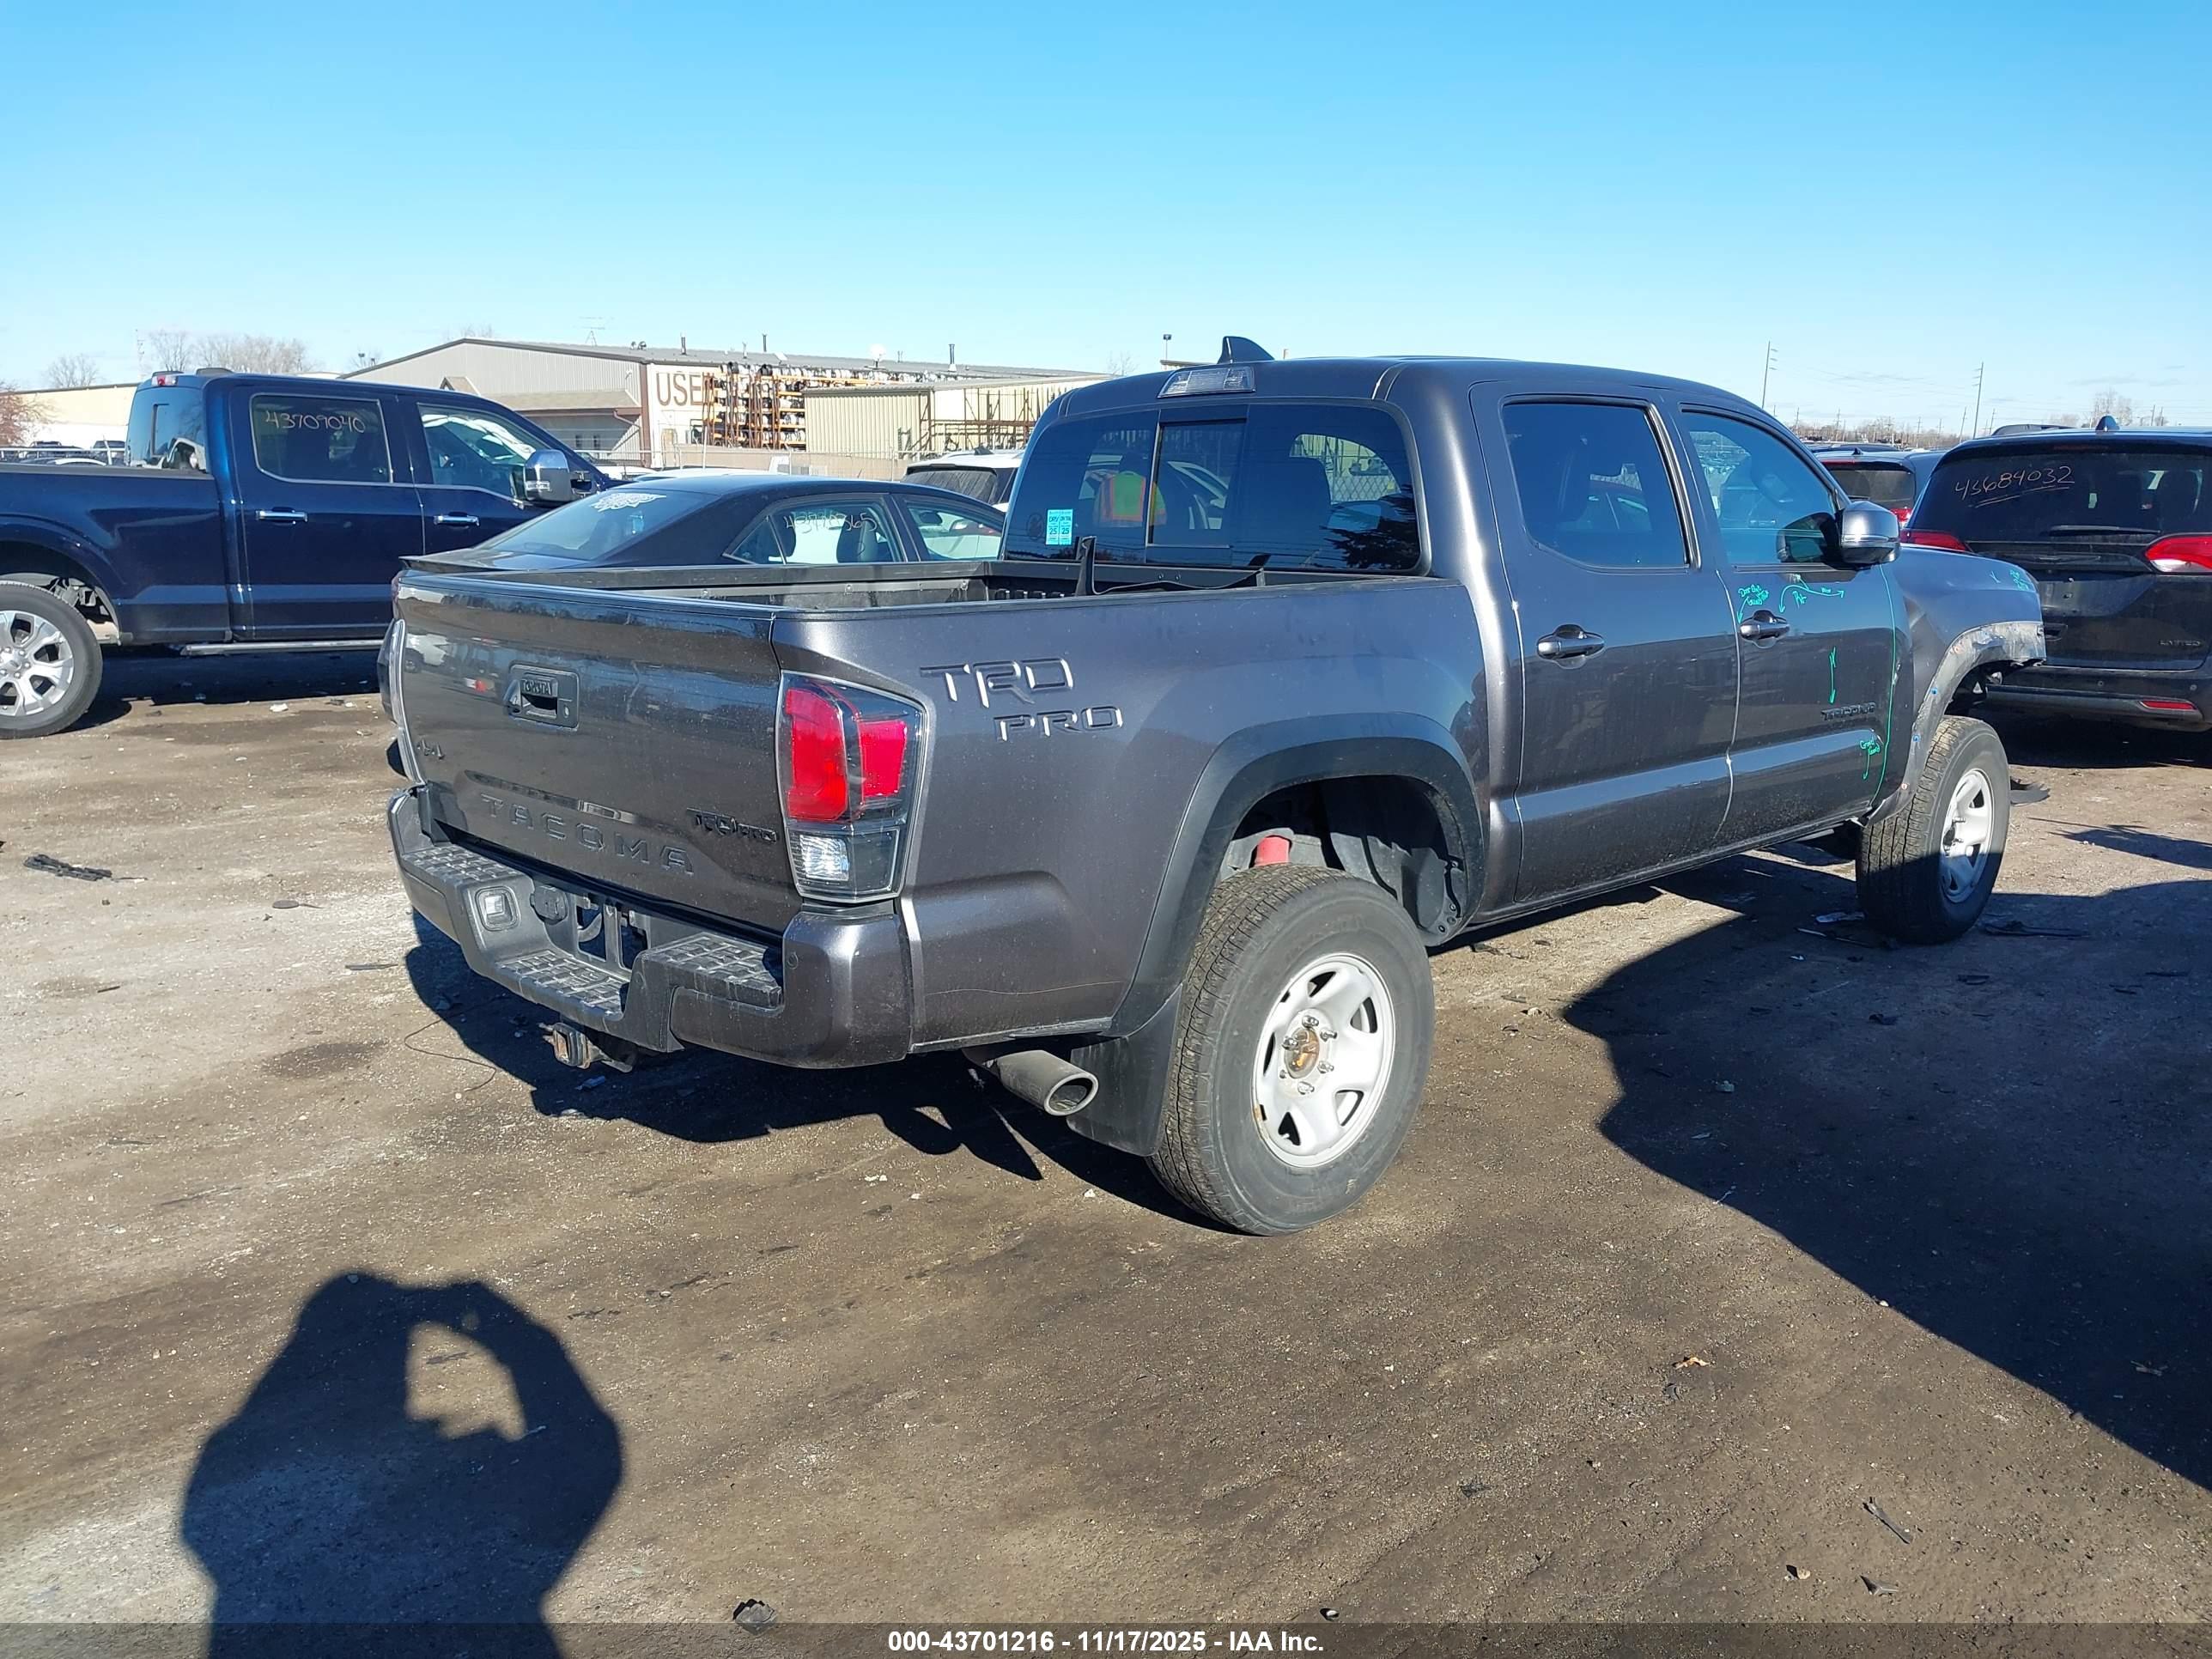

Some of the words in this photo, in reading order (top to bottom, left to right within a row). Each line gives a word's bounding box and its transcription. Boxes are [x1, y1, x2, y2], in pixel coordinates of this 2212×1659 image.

[265, 410, 366, 433] 43709040
[522, 679, 552, 695] TOYOTA
[920, 658, 1074, 708] TRD
[994, 706, 1123, 742] PRO
[479, 793, 694, 875] TACOMA
